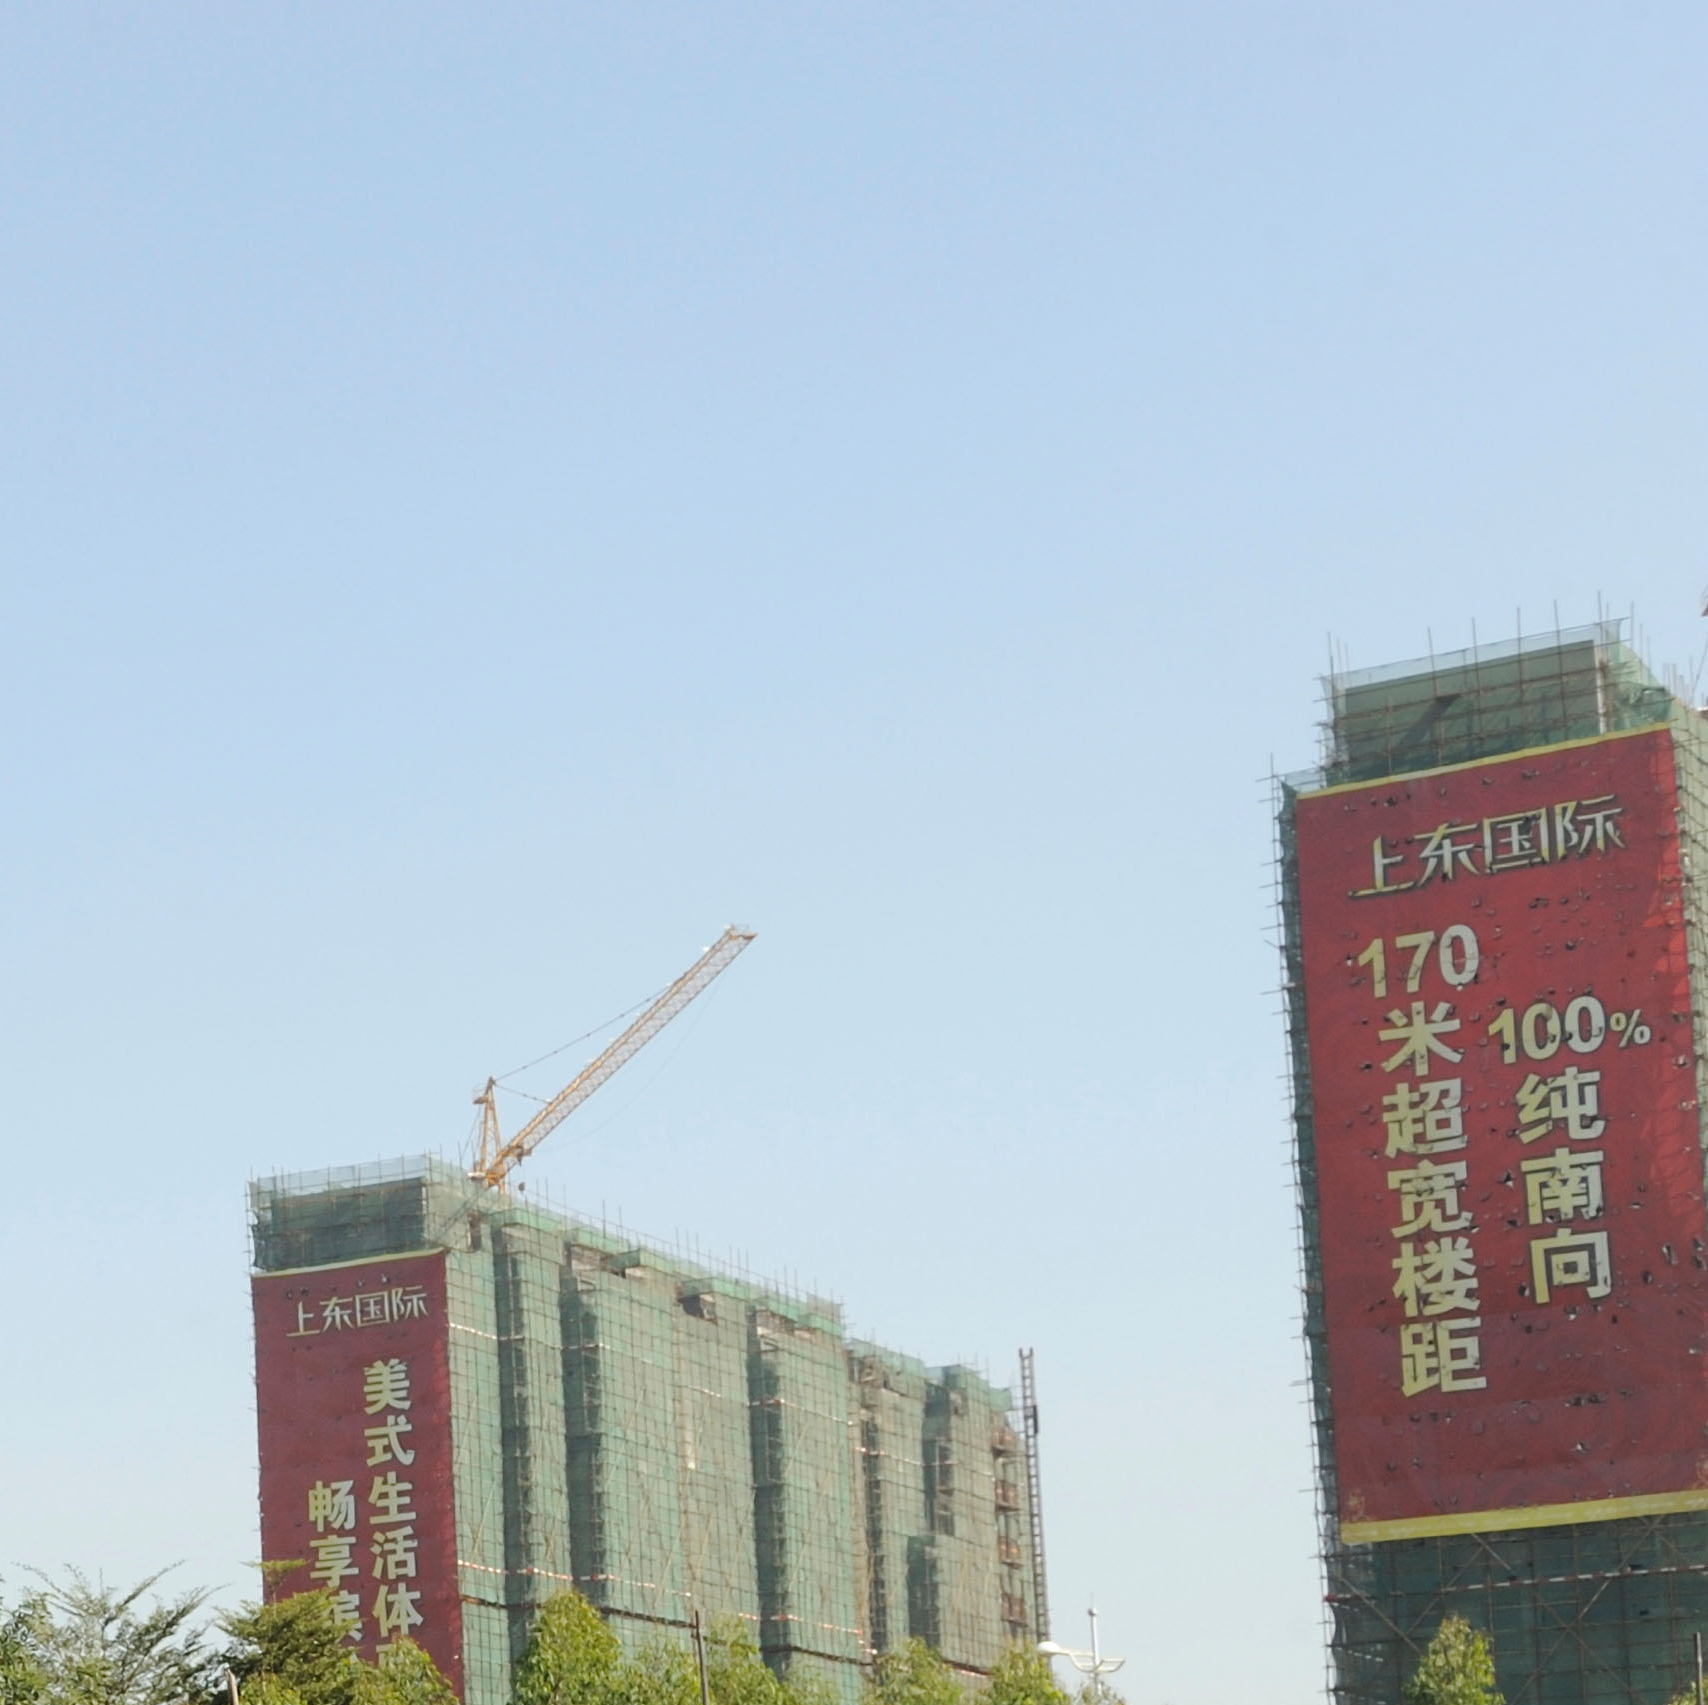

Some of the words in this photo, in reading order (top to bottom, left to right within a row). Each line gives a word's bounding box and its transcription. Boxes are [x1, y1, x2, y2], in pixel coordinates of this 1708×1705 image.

[1347, 795, 1627, 899] 上东国际
[1358, 925, 1489, 1399] 170米超宽楼距
[1487, 995, 1652, 1305] 100%纯南向
[286, 1286, 428, 1338] 上东国际
[308, 1480, 363, 1662] 畅享
[363, 1358, 424, 1668] 美式生活体
